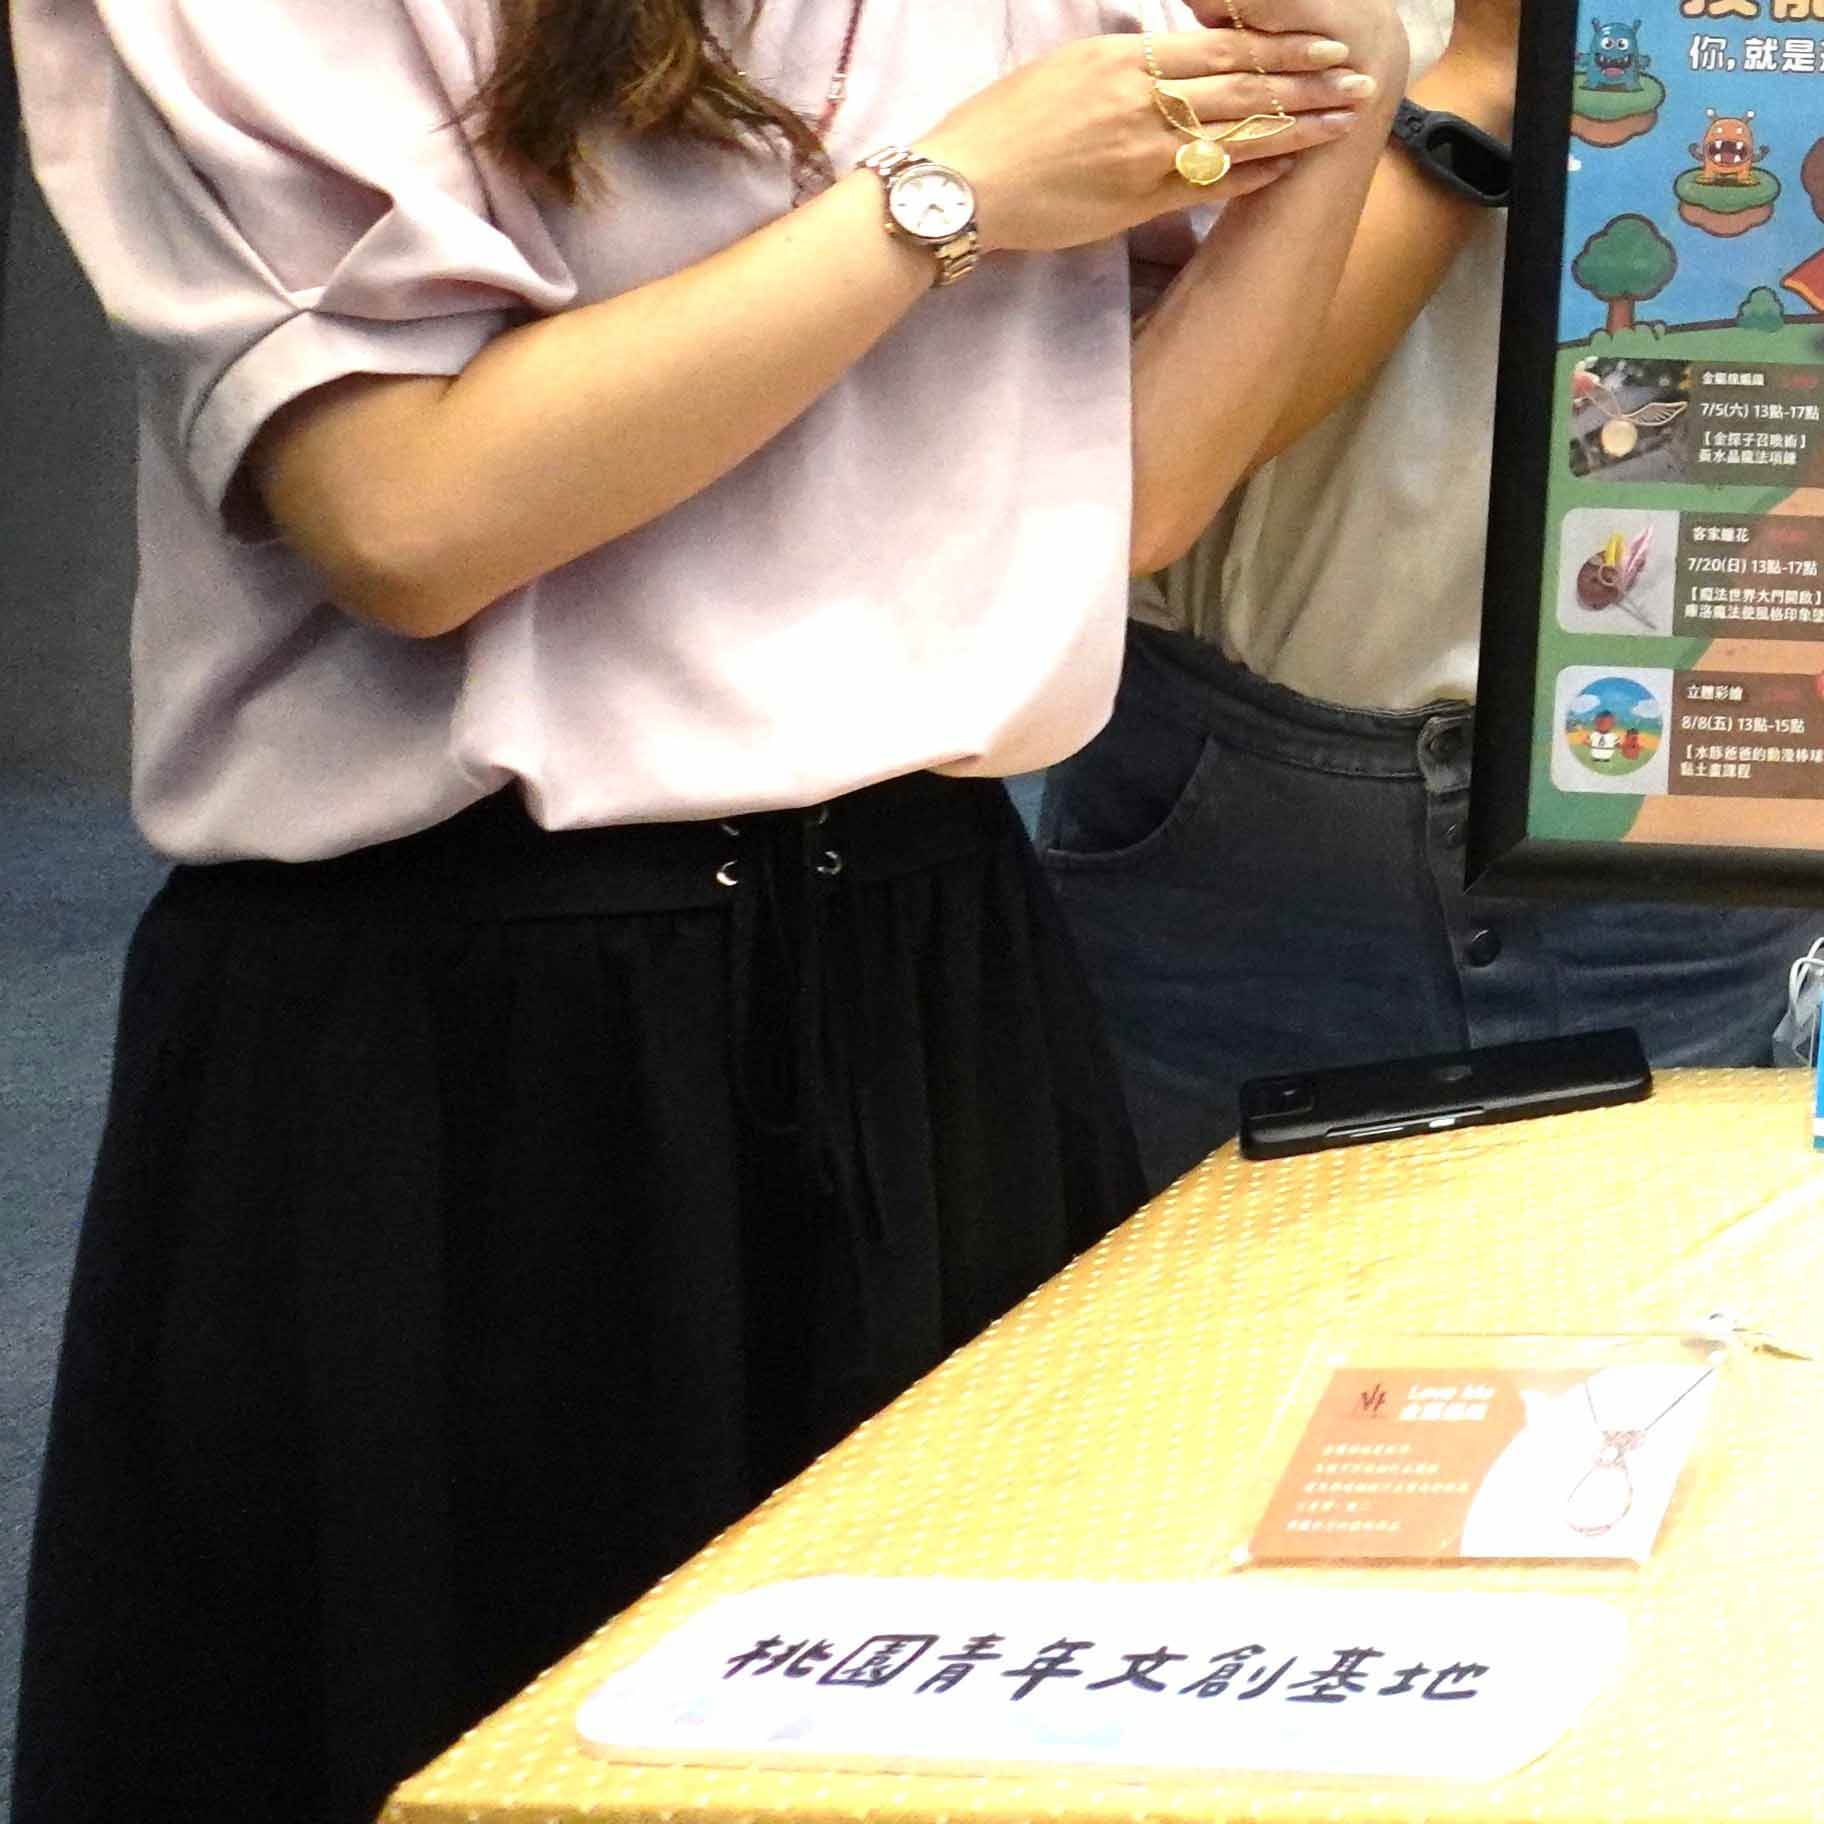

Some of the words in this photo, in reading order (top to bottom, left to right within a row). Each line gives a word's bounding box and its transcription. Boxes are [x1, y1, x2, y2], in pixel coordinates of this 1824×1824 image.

[1700, 403, 1750, 419] 7/5(六)
[1687, 558, 1747, 575] 7/20(日)
[1681, 716, 1733, 732] 8/8(五)
[722, 1633, 1492, 1704] 桃園青年文創基地
